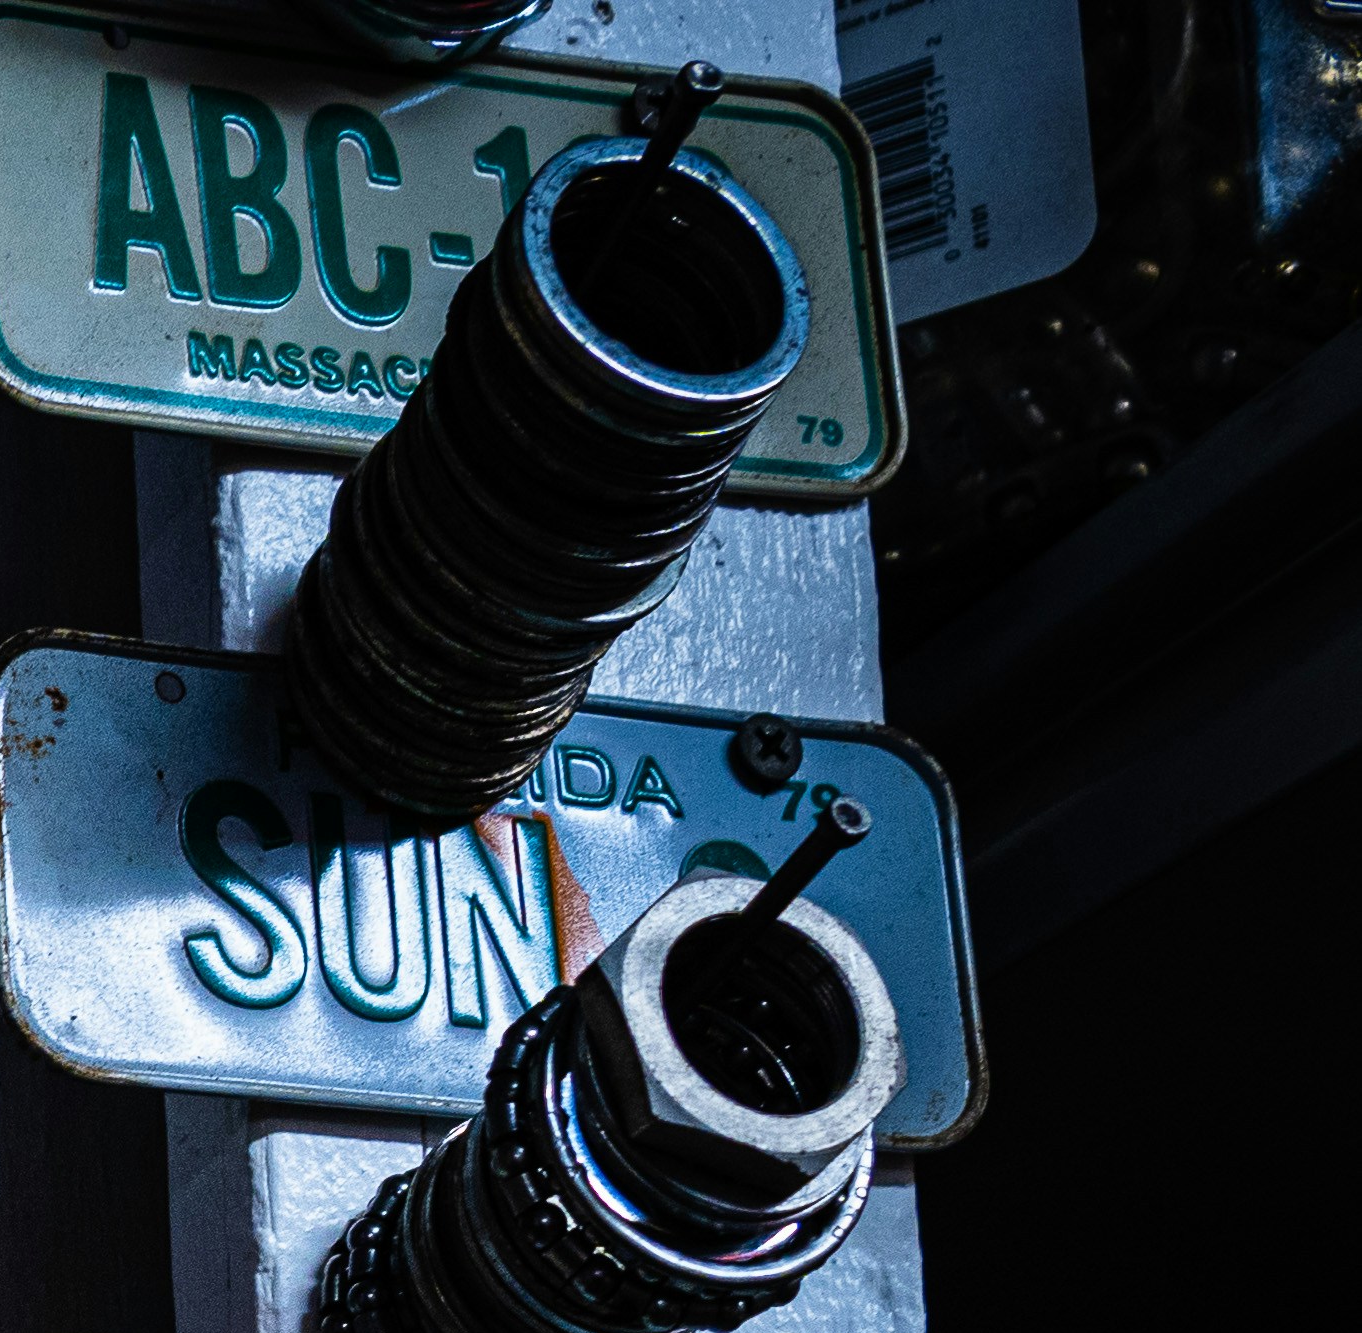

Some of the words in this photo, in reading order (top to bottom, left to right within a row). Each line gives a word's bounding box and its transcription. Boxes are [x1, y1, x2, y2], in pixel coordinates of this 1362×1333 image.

[186, 330, 437, 401] MASSAC
[796, 414, 844, 448] 79
[181, 776, 564, 1030] SUN
